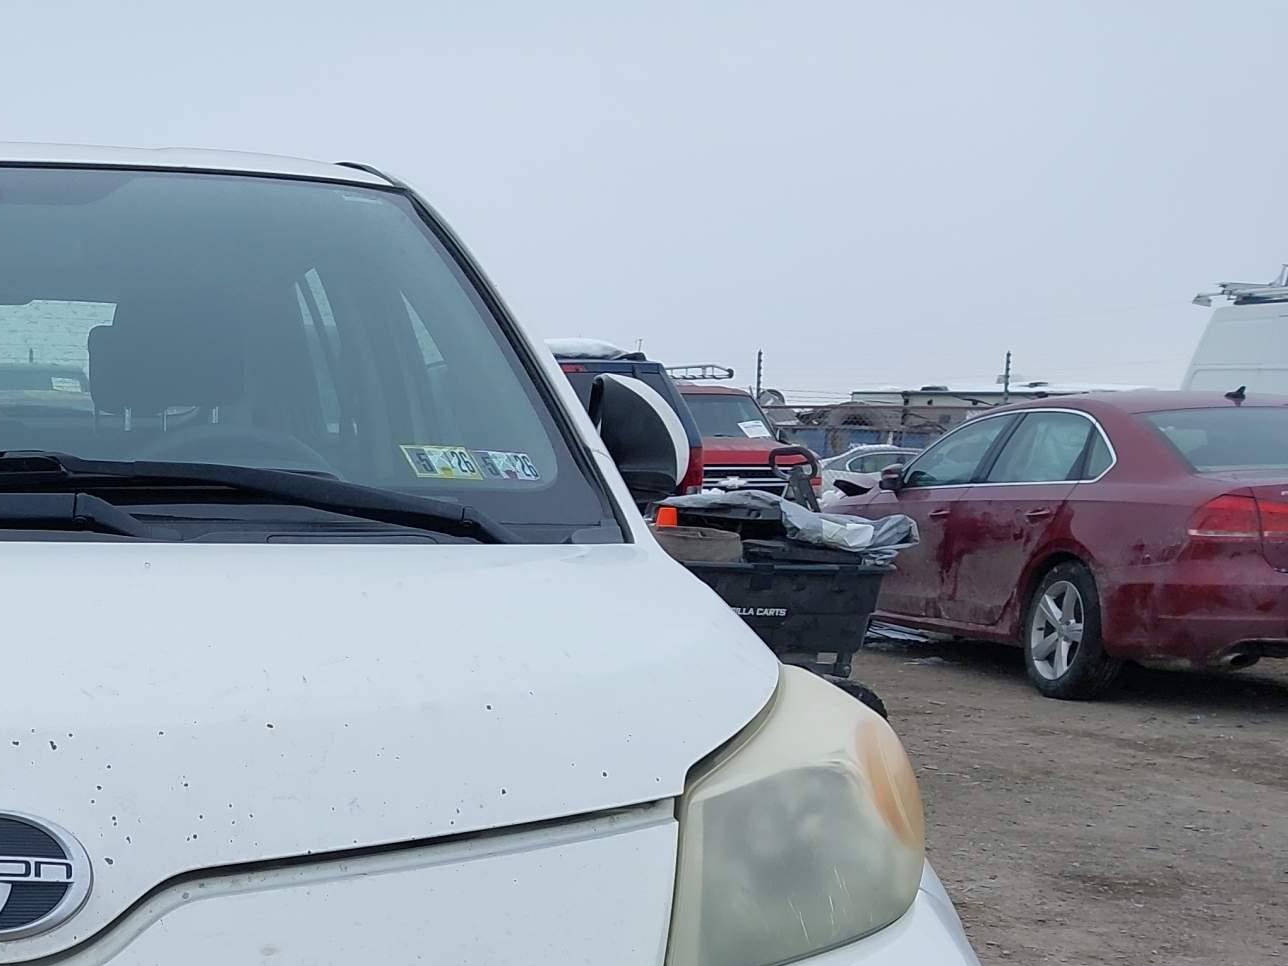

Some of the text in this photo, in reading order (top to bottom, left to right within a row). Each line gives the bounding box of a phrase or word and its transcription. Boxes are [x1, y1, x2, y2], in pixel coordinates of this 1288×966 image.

[416, 452, 435, 472] 5
[481, 456, 501, 476] 5
[756, 608, 787, 616] CARTS
